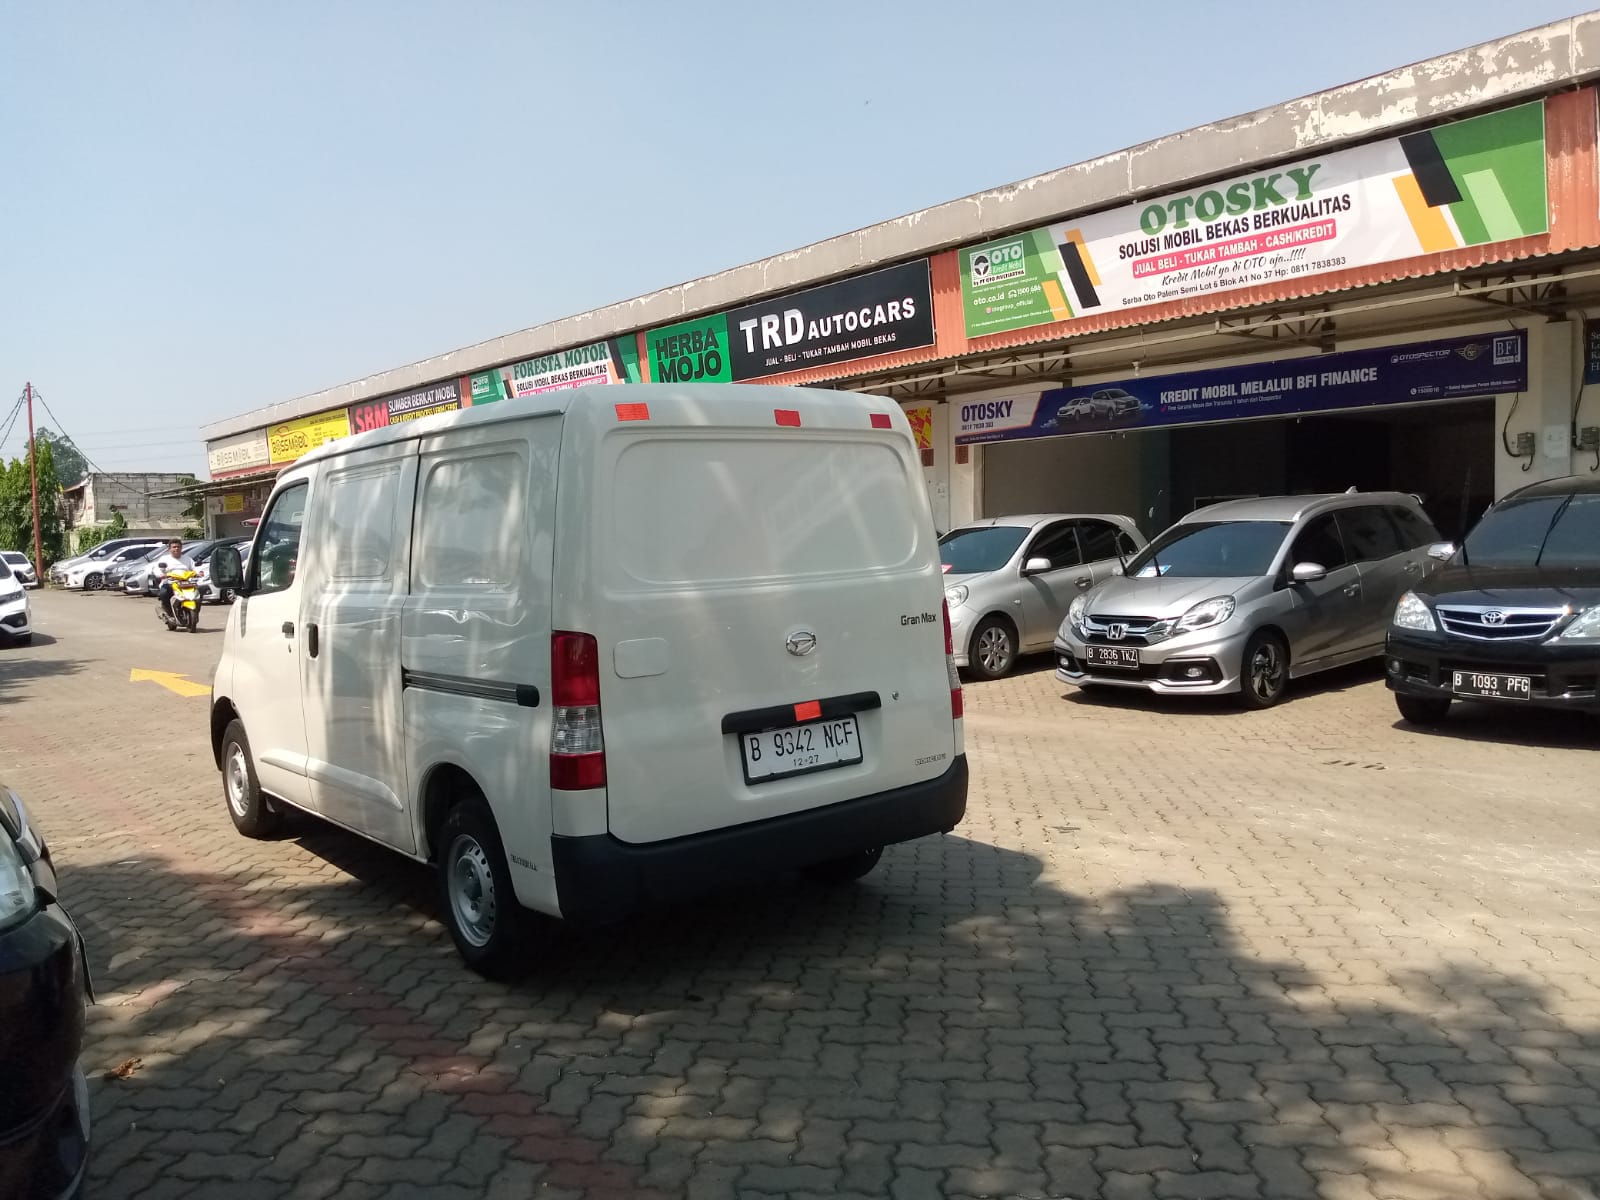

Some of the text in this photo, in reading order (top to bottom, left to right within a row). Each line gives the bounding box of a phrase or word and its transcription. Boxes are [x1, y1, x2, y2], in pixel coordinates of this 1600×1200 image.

[1140, 164, 1321, 236] OTOSKY
[1119, 194, 1352, 260] SOLUSI MOBIL BEKAS BERKUALITAS
[991, 245, 1023, 264] OTO
[1135, 261, 1156, 275] JUAL
[1158, 257, 1178, 271] BELI
[1184, 251, 1216, 265] TUKAR
[1218, 241, 1258, 257] TAMBAH
[1266, 223, 1334, 248] CASH/KREDIT
[1157, 289, 1179, 299] Palem
[1181, 285, 1198, 295] Semi
[1199, 282, 1212, 291] Lot
[1219, 277, 1237, 287] Blok
[1238, 275, 1249, 284] A1
[1250, 273, 1262, 281] No
[1263, 270, 1273, 279] 37
[1290, 263, 1309, 274] 0811
[1311, 256, 1346, 270] 7838383
[1162, 272, 1189, 286] Kredit
[1191, 264, 1217, 280] Mobil
[1233, 261, 1242, 272] di
[1244, 256, 1266, 270] OTO
[973, 292, 1005, 306] oto.co.id
[739, 307, 805, 354] TRD
[807, 297, 916, 341] AUTOCARS
[655, 328, 719, 360] HERBA
[783, 354, 796, 364] BELI
[802, 348, 822, 360] TUKAR
[823, 342, 849, 357] TAMBAH
[850, 339, 872, 351] MOBIL
[873, 333, 896, 346] BEKAS
[513, 343, 608, 380] FORESTA MOTOR
[550, 372, 568, 385] BEKAS
[569, 364, 608, 381] BERKUALITAS
[658, 349, 722, 383] MOJO
[388, 385, 457, 412] SUMBER BERKAT MOBIL
[1160, 367, 1379, 405] KREDIT MOBIL MELALUI BFI FINANCE
[355, 401, 390, 434] SBM
[961, 399, 1014, 422] OTOSKY
[900, 612, 937, 627] Gran Max
[1088, 647, 1137, 662] B 2836 TKZ
[1455, 673, 1529, 692] B 1093 PFG
[750, 721, 853, 762] B 9342 NCF
